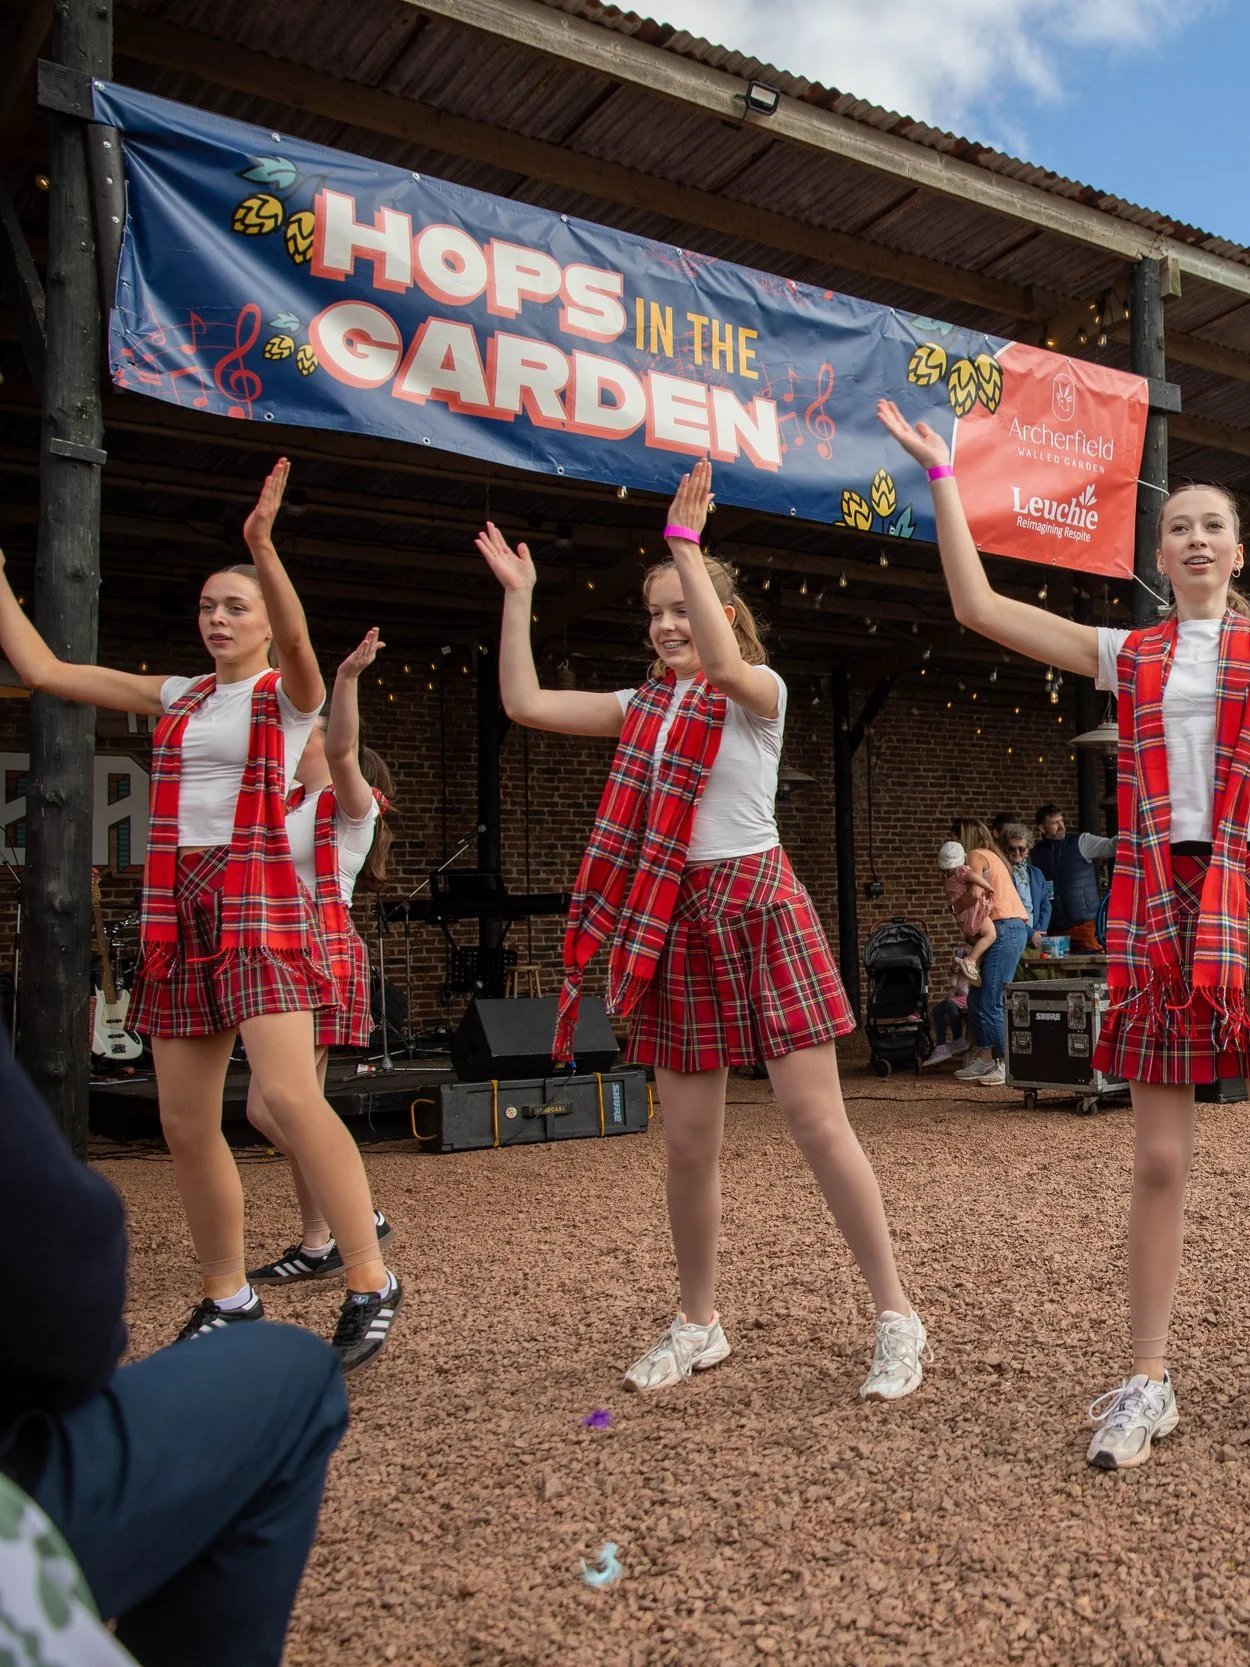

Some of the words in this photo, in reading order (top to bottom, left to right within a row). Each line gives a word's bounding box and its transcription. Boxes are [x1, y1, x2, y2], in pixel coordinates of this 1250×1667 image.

[310, 188, 627, 343] HOPS
[635, 297, 674, 357] IN
[686, 312, 759, 380] THE
[308, 299, 779, 472] GARDEN
[1008, 417, 1114, 461] Archerfield
[1018, 447, 1060, 464] WALLED
[1064, 456, 1105, 474] GARDEN
[1011, 486, 1099, 530] Leuchie
[1016, 516, 1063, 539] Reimagining
[1064, 527, 1091, 543] Respite
[1035, 1012, 1061, 1021] SHURE
[611, 1082, 622, 1123] SHURE
